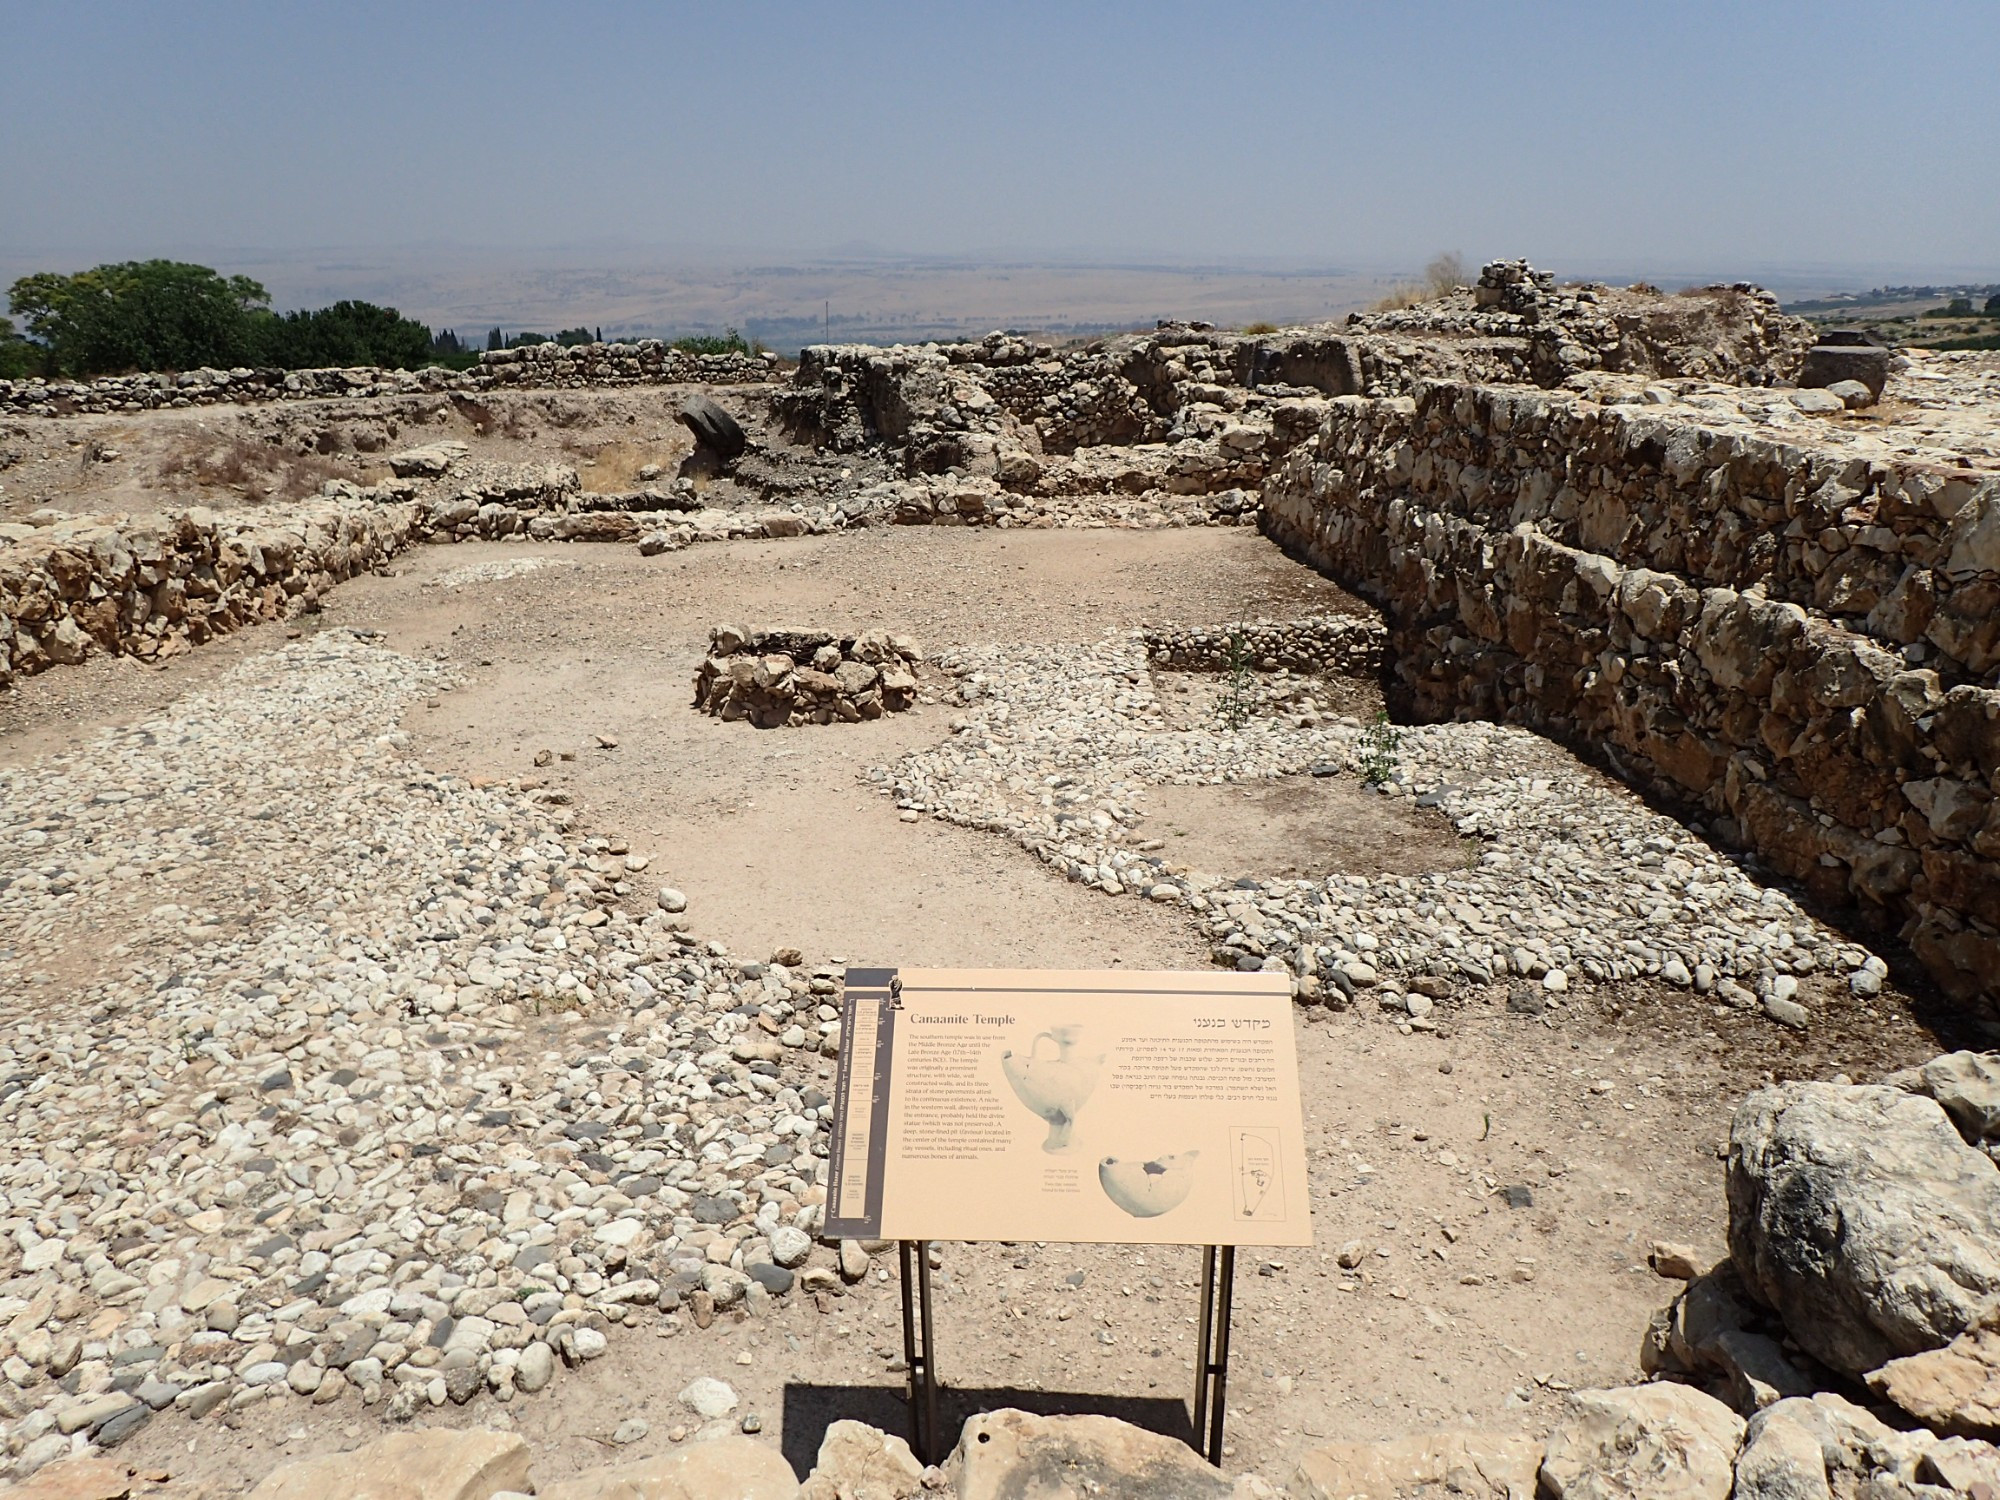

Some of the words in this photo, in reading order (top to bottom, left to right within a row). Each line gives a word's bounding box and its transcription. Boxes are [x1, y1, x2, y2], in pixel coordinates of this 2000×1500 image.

[910, 1014, 968, 1024] Canaanite
[973, 1014, 1016, 1027] Temple
[1194, 1018, 1226, 1028] כנעני
[1232, 1018, 1270, 1030] מקדש
